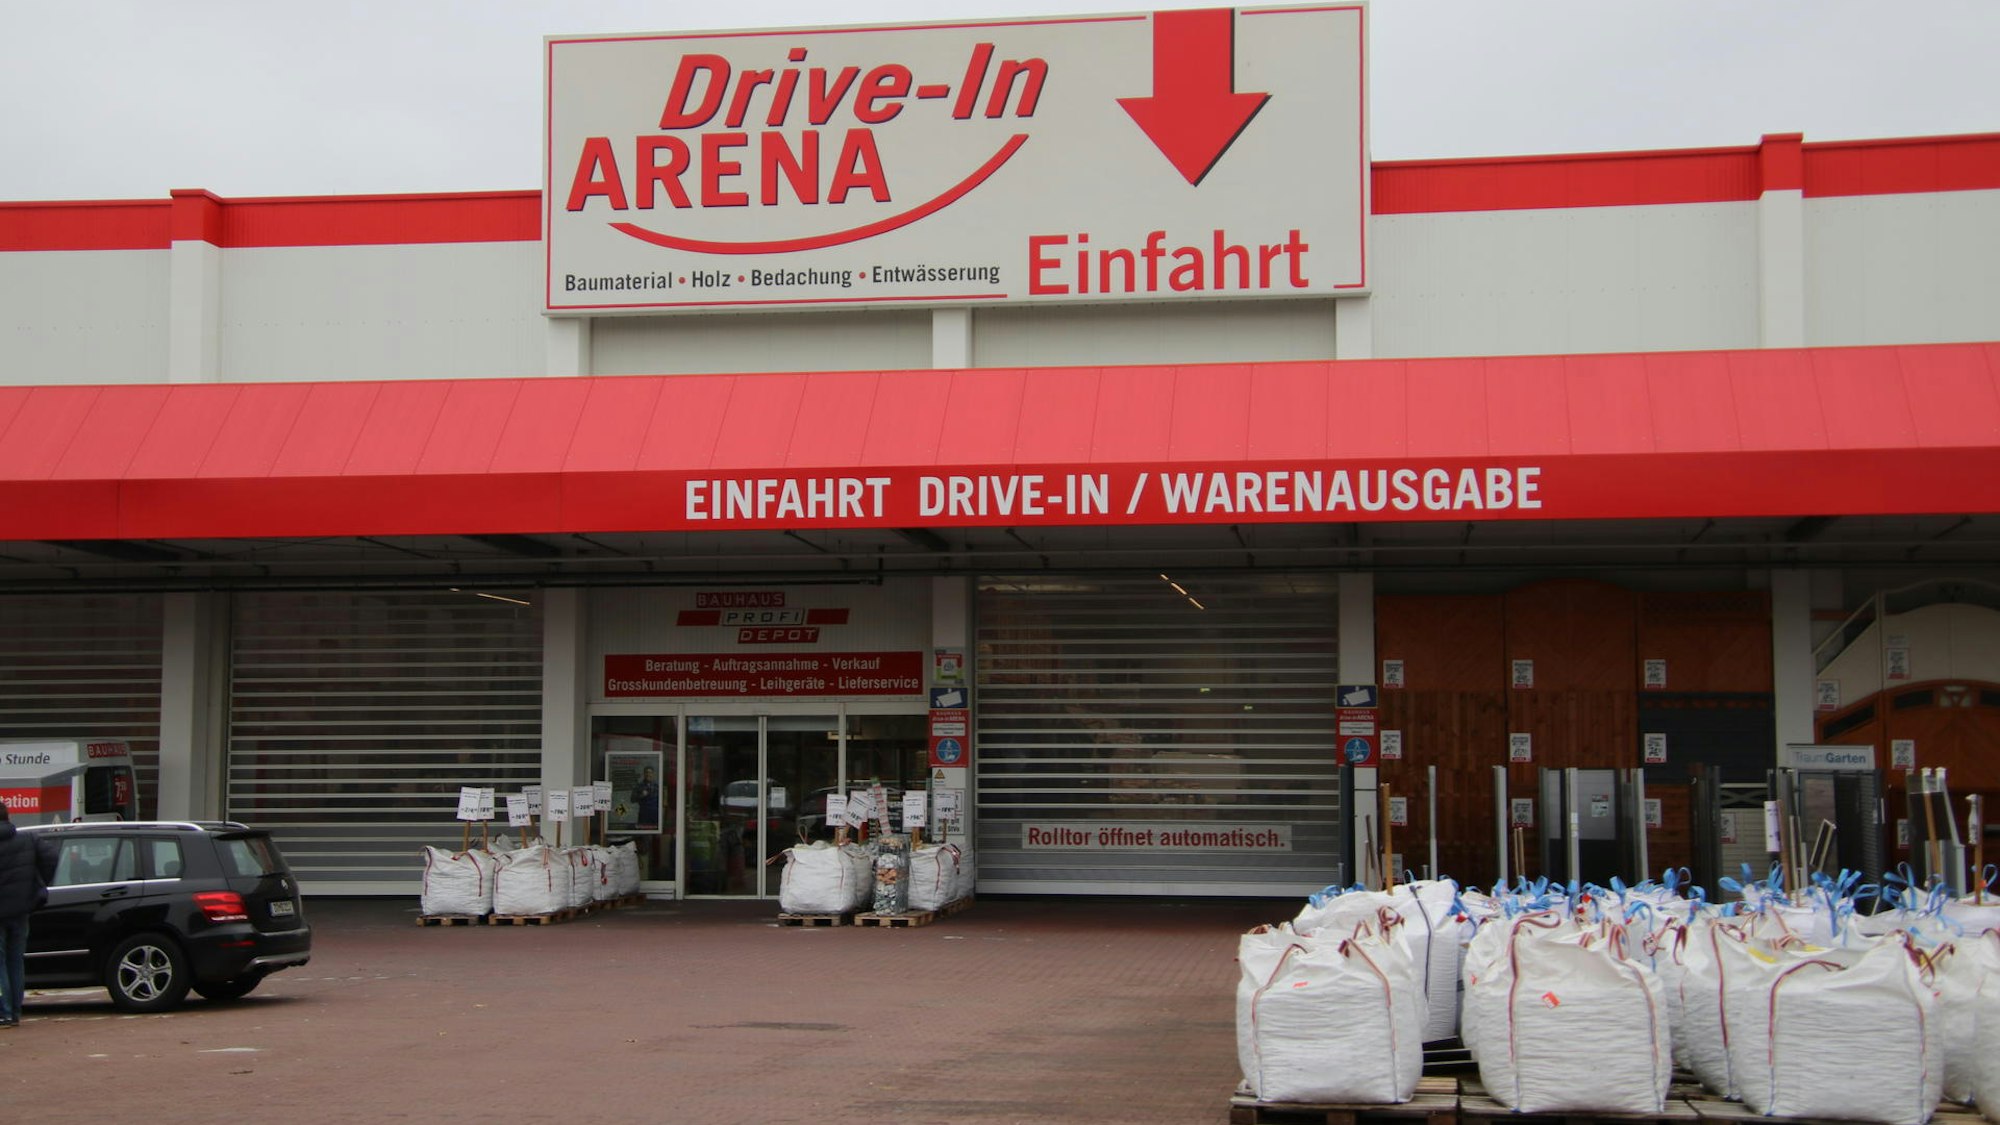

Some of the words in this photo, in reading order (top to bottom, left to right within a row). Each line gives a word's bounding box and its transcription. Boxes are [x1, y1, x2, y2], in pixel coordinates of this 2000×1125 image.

[659, 43, 1048, 129] Drive-In
[566, 128, 892, 211] ARENA
[1029, 229, 1309, 295] Einfahrt
[565, 272, 672, 291] Baumaterial
[692, 270, 731, 288] Holz
[751, 268, 852, 288] Bedachung
[872, 265, 1000, 284] Entwässerung
[685, 477, 891, 519] EINFAHRT
[918, 474, 1109, 516] DRIVE-IN
[1160, 467, 1542, 514] WARENAUSGABE
[697, 593, 784, 607] BAUHAUS
[726, 611, 800, 623] PROFI
[740, 629, 817, 641] DEPOT
[645, 659, 700, 674] Beratung
[712, 658, 819, 673] Auftragsannahme
[832, 657, 881, 671] Verkauf
[608, 677, 748, 692] Grosskundenbetreuung
[760, 676, 825, 692] Leihgeräte
[838, 675, 919, 690] Lieferservice
[5, 752, 51, 765] Stunde
[1028, 827, 1092, 846] Rolltor
[1099, 827, 1154, 846] öffnet
[1160, 829, 1285, 848] automatisch.
